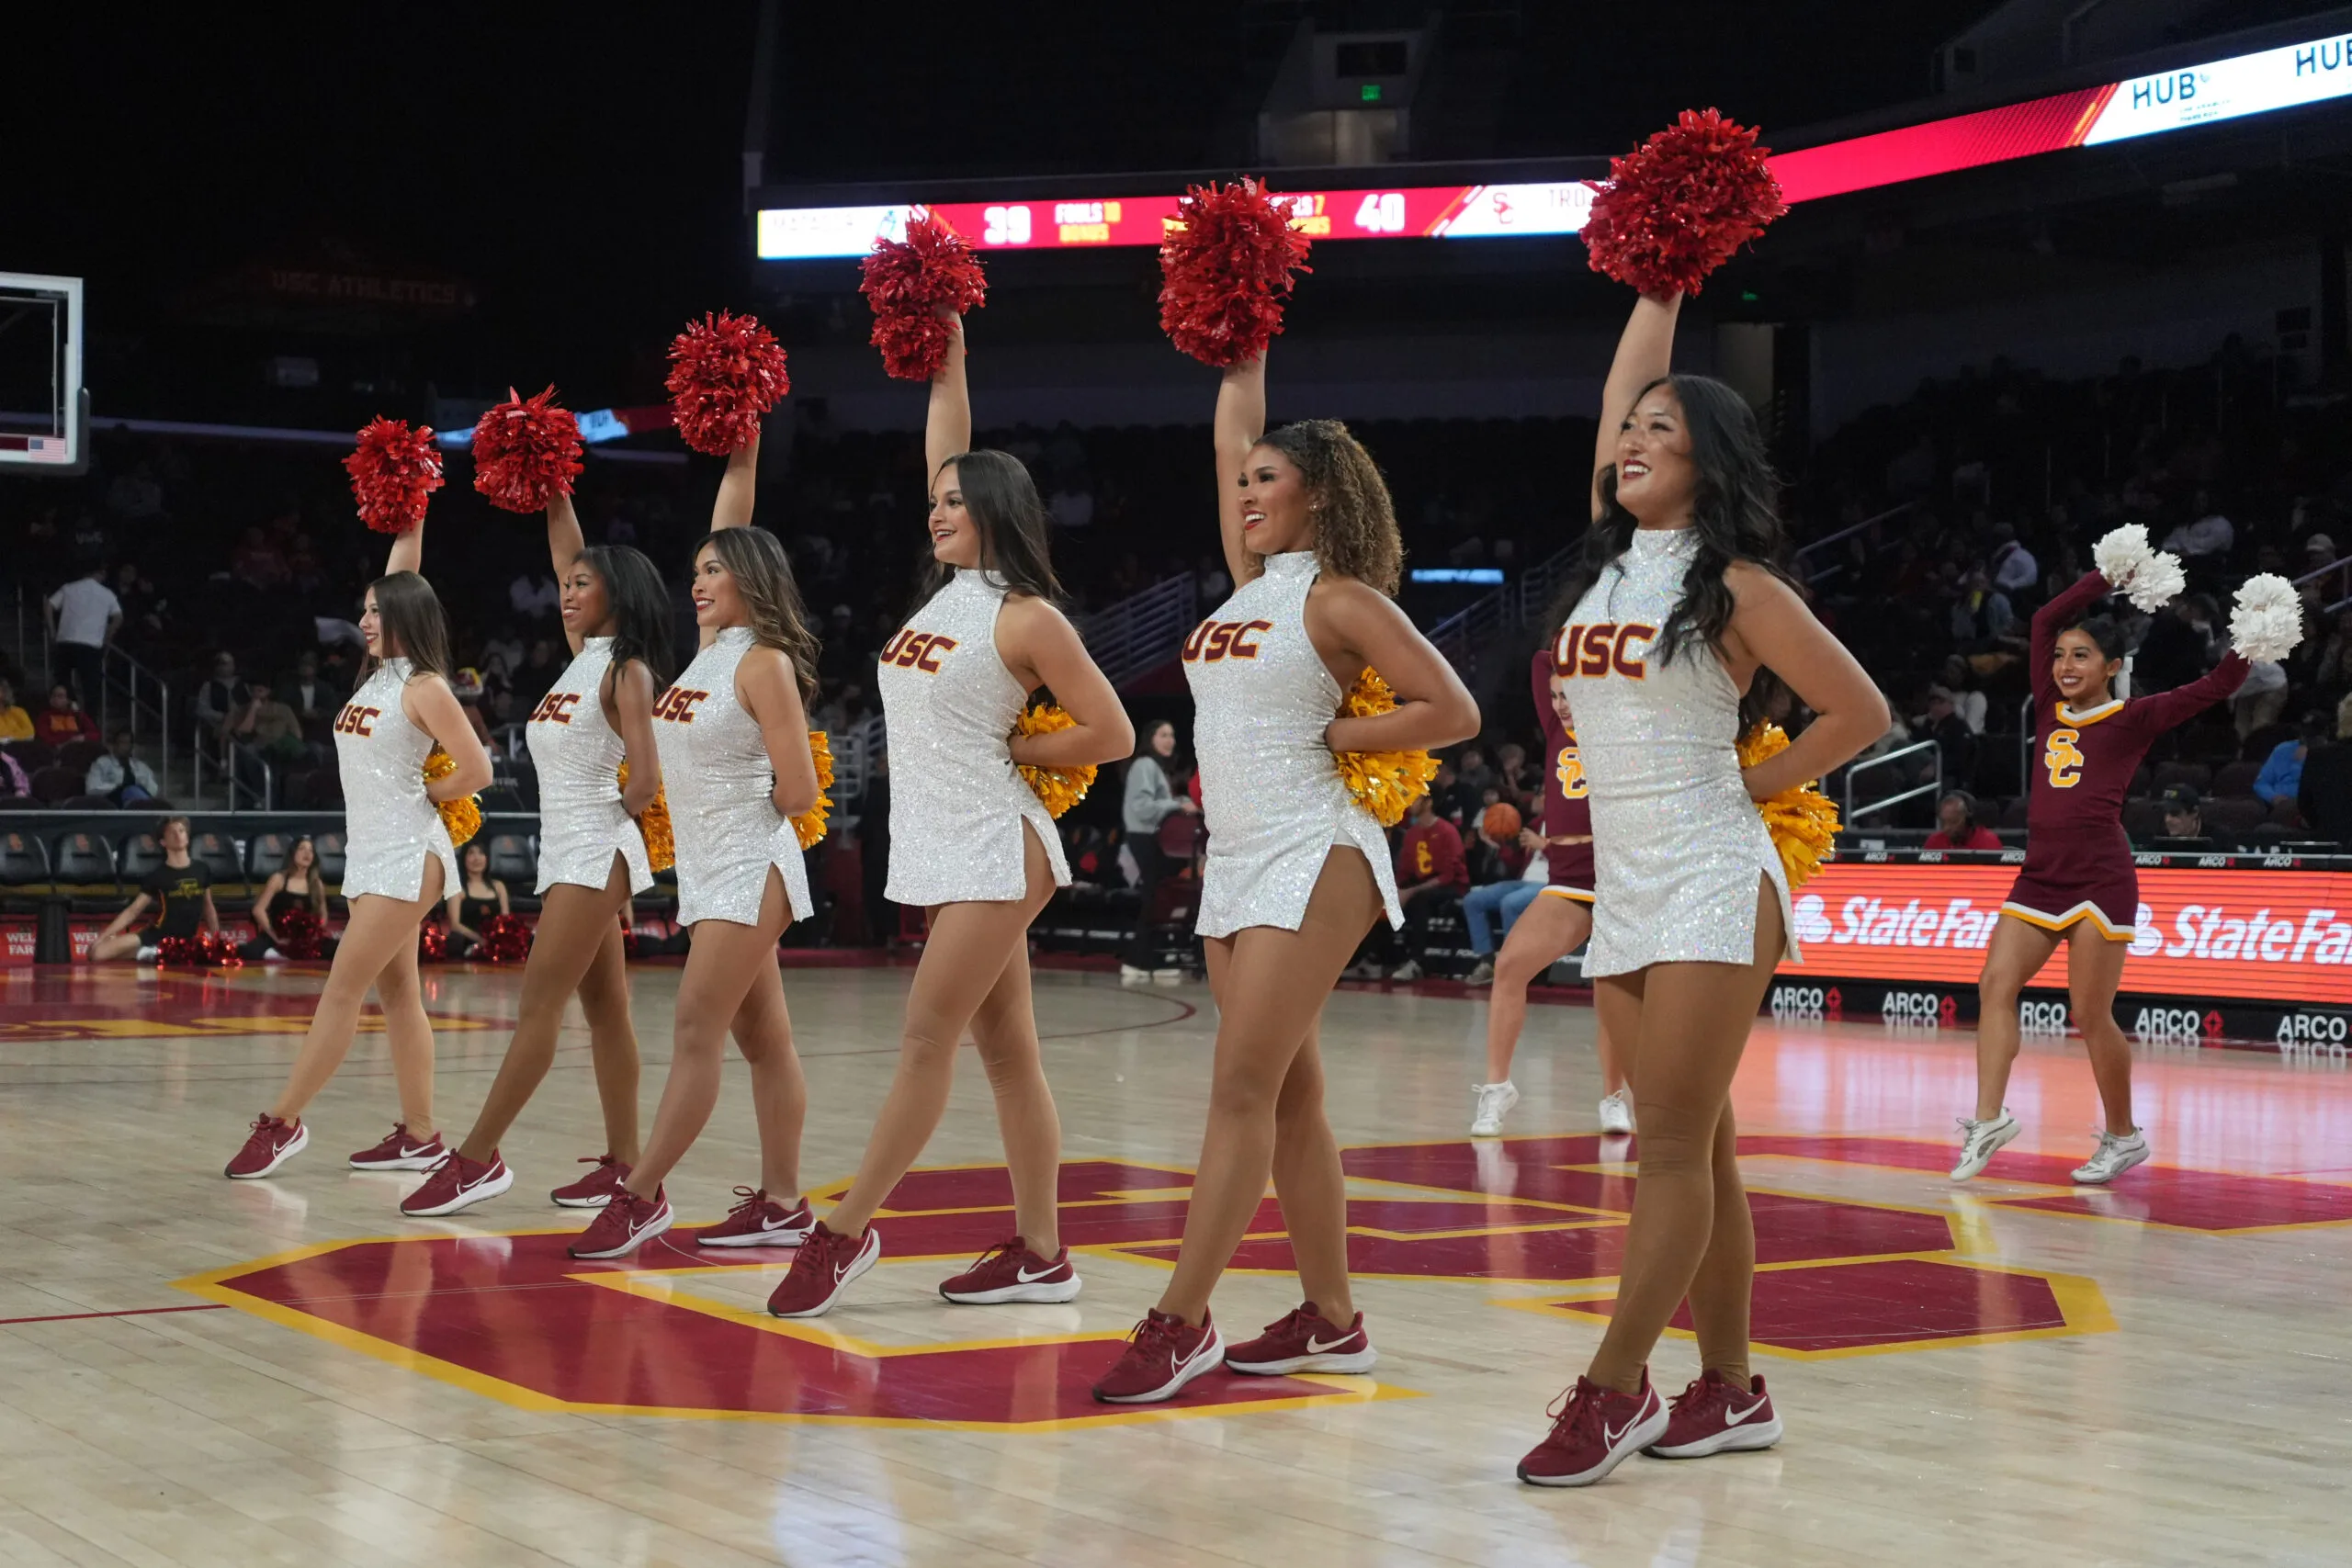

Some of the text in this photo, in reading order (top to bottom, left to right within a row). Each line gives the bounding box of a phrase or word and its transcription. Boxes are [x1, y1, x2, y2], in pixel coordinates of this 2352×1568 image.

[2132, 73, 2196, 110] HUB
[1547, 186, 1589, 209] TRO
[1354, 193, 1406, 232] 40
[273, 269, 458, 305] USC ATHLETICS
[879, 626, 961, 676] USC
[1182, 618, 1275, 663] USC
[1551, 623, 1657, 681] USC
[527, 693, 582, 725] USC
[651, 684, 710, 725] USC
[334, 703, 382, 738] USC
[1864, 852, 1887, 863] ARCO
[1918, 852, 1942, 863] ARCO
[2134, 854, 2162, 866] ARCO
[2198, 855, 2226, 868] ARCO
[2263, 855, 2292, 868] ARCO
[6, 931, 36, 943] WEL
[8, 944, 35, 955] FAR
[1771, 987, 1825, 1010] ARCO
[1883, 991, 1939, 1015] ARCO
[2019, 1001, 2067, 1026] RCO
[2134, 1008, 2200, 1035] ARCO
[2277, 1014, 2347, 1042] ARCO
